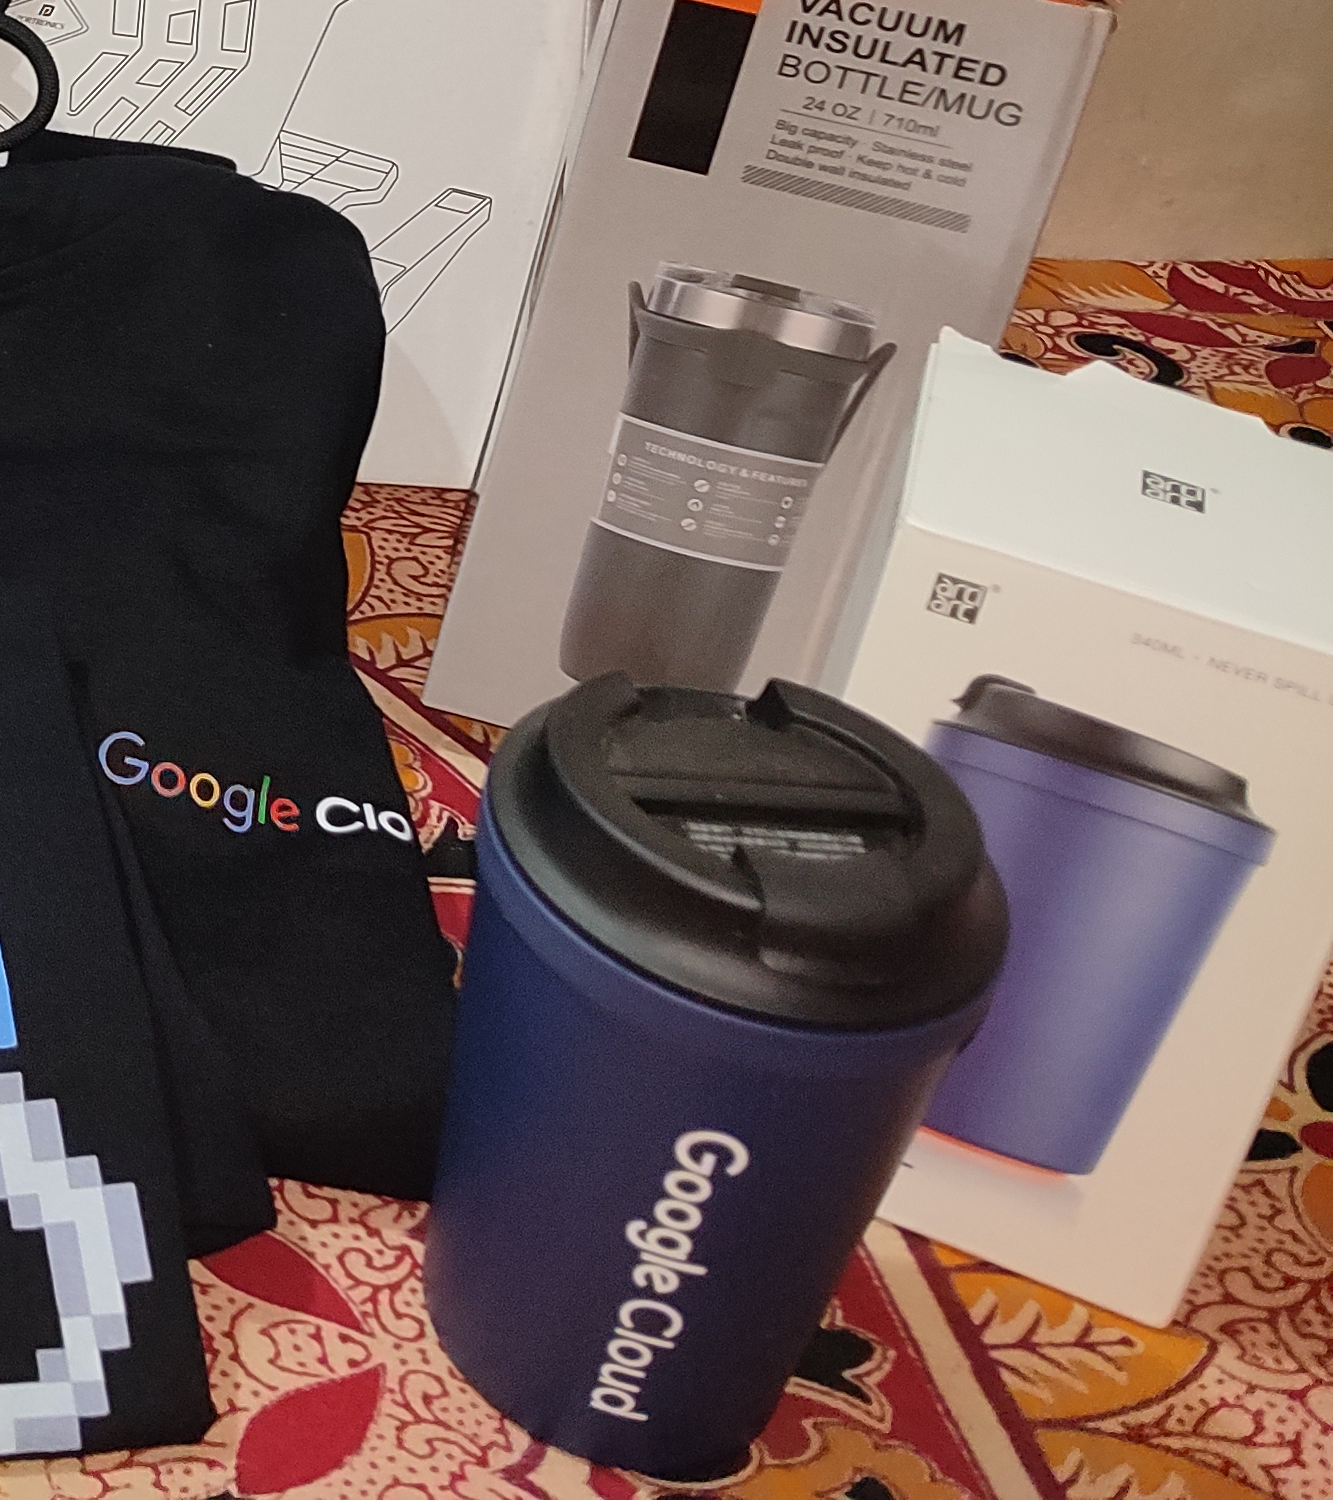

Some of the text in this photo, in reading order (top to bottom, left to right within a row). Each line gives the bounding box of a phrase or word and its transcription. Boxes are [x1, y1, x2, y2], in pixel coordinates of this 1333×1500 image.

[785, 20, 1008, 87] INSULATED
[778, 53, 1024, 127] BOTTLE/MUG
[802, 96, 826, 111] 24
[831, 102, 862, 121] OZ
[770, 134, 804, 151] Leak
[807, 144, 845, 160] proof
[855, 154, 894, 171] Keep
[775, 119, 799, 135] Big
[801, 127, 858, 149] capacity
[765, 149, 815, 169] Double
[644, 441, 738, 475] TECHNOLOGY
[98, 730, 414, 842] Google Clo
[590, 1129, 749, 1422] Google Cloud
